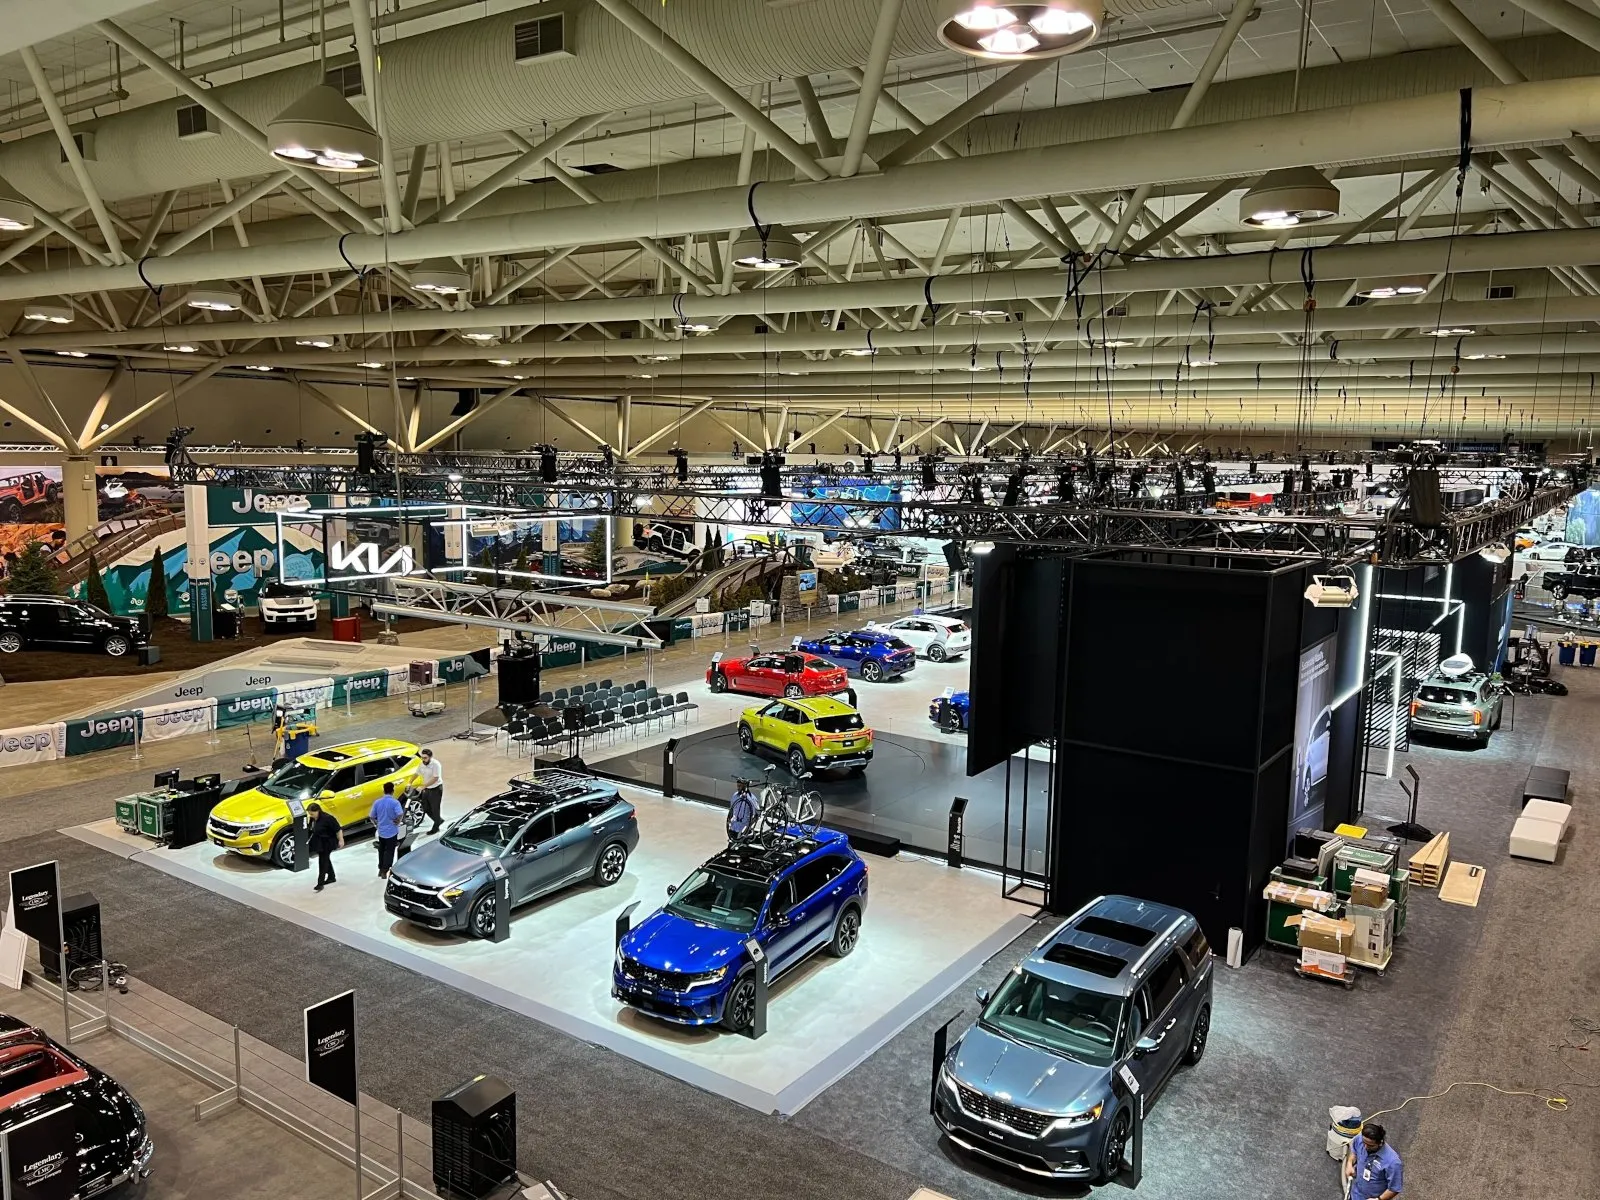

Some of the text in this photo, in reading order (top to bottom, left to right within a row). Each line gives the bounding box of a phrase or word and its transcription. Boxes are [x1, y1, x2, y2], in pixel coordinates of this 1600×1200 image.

[183, 548, 275, 578] eep
[331, 540, 413, 577] KIA
[245, 676, 272, 686] Jeep
[174, 686, 204, 698] Jeep
[228, 697, 272, 713] Jeep
[80, 716, 135, 738] Jeep
[0, 732, 52, 752] eep
[318, 1029, 345, 1045] Legendary
[23, 1151, 64, 1173] Legendary
